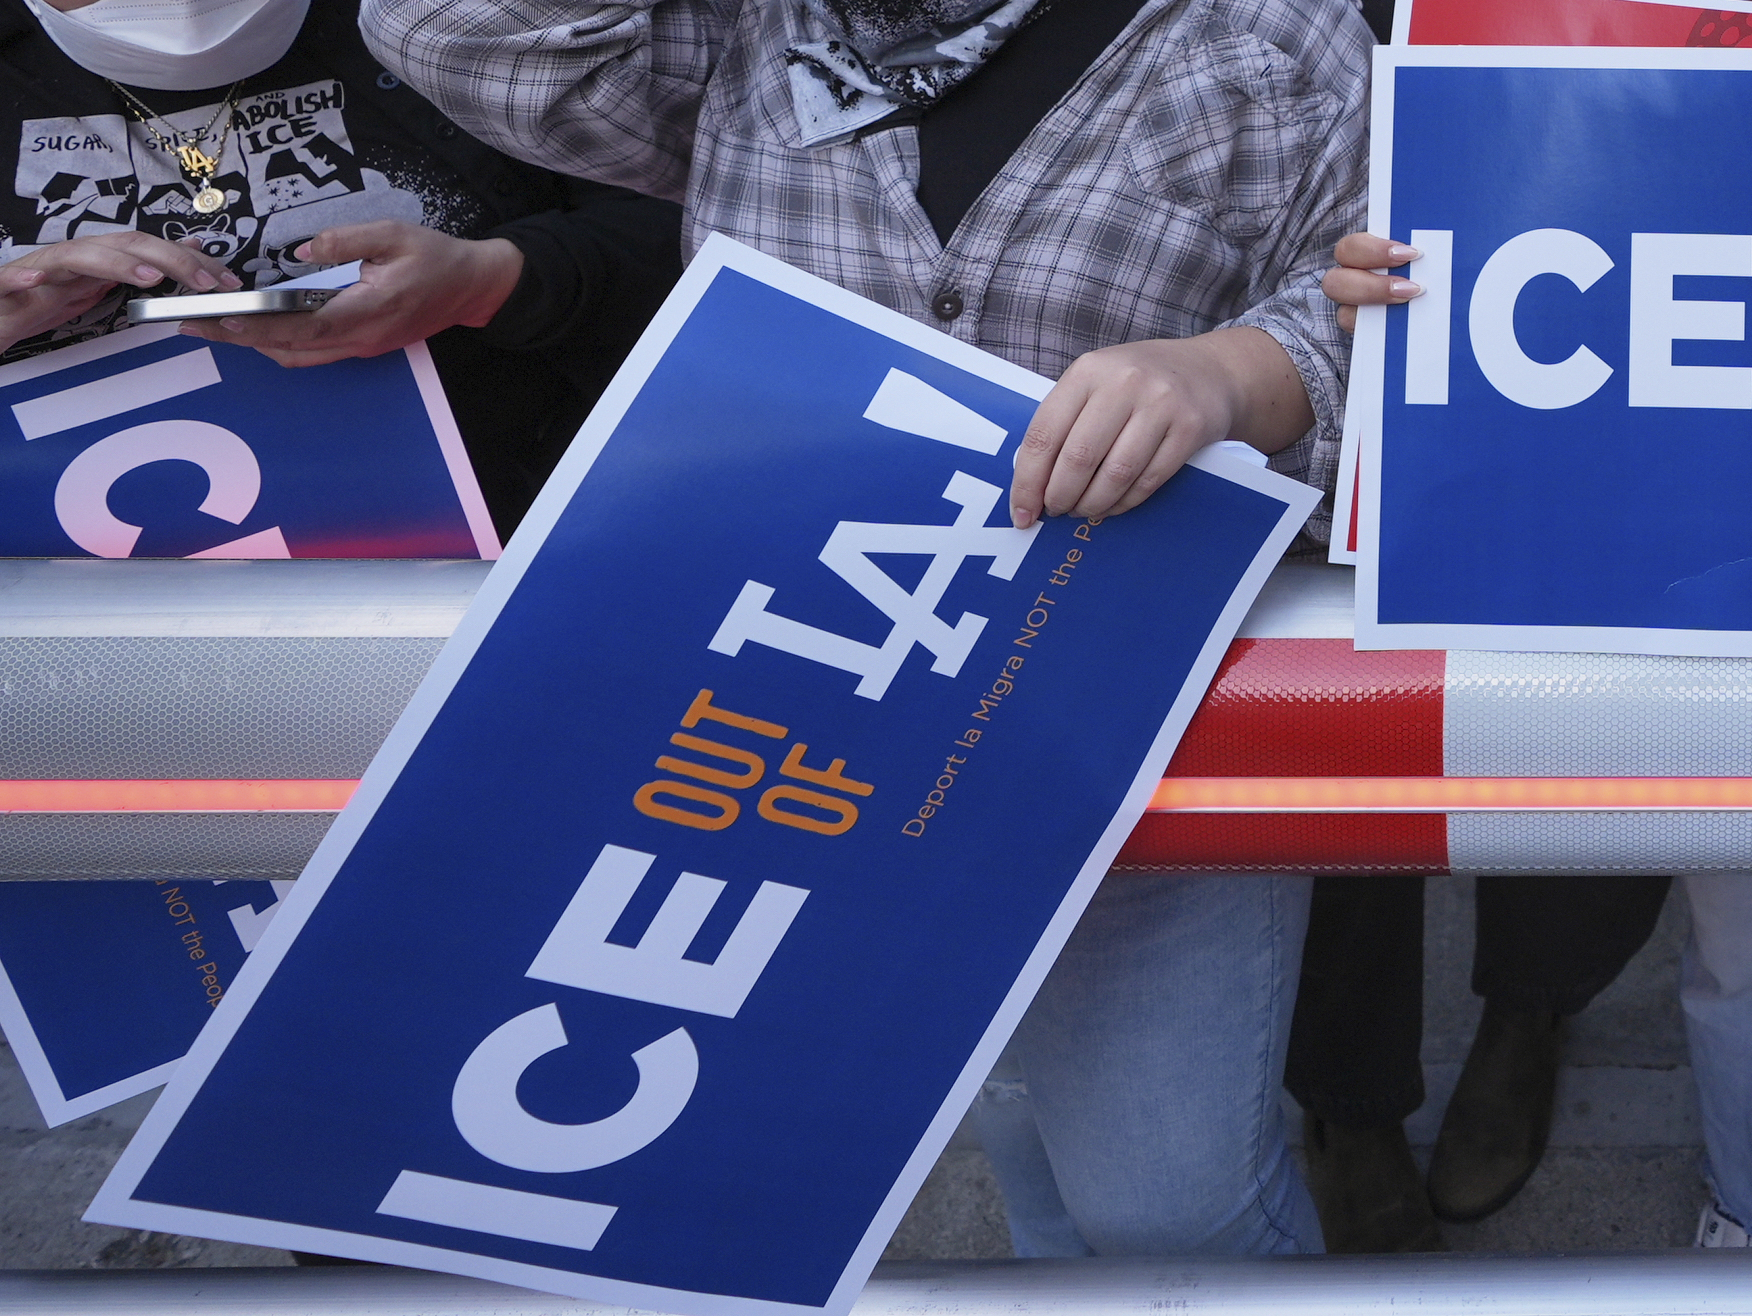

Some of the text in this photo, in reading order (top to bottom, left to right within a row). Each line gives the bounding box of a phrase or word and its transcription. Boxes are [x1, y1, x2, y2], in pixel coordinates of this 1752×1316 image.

[231, 81, 344, 132] ABOLISH
[255, 91, 286, 102] AND
[245, 115, 318, 155] ICE
[11, 346, 291, 558] IC
[901, 547, 1084, 838] Deport la Migra NOT the
[160, 886, 197, 927] NOT
[181, 929, 206, 961] the
[375, 842, 812, 1252] ICE
[632, 688, 790, 832] OUT
[756, 742, 875, 837] OF
